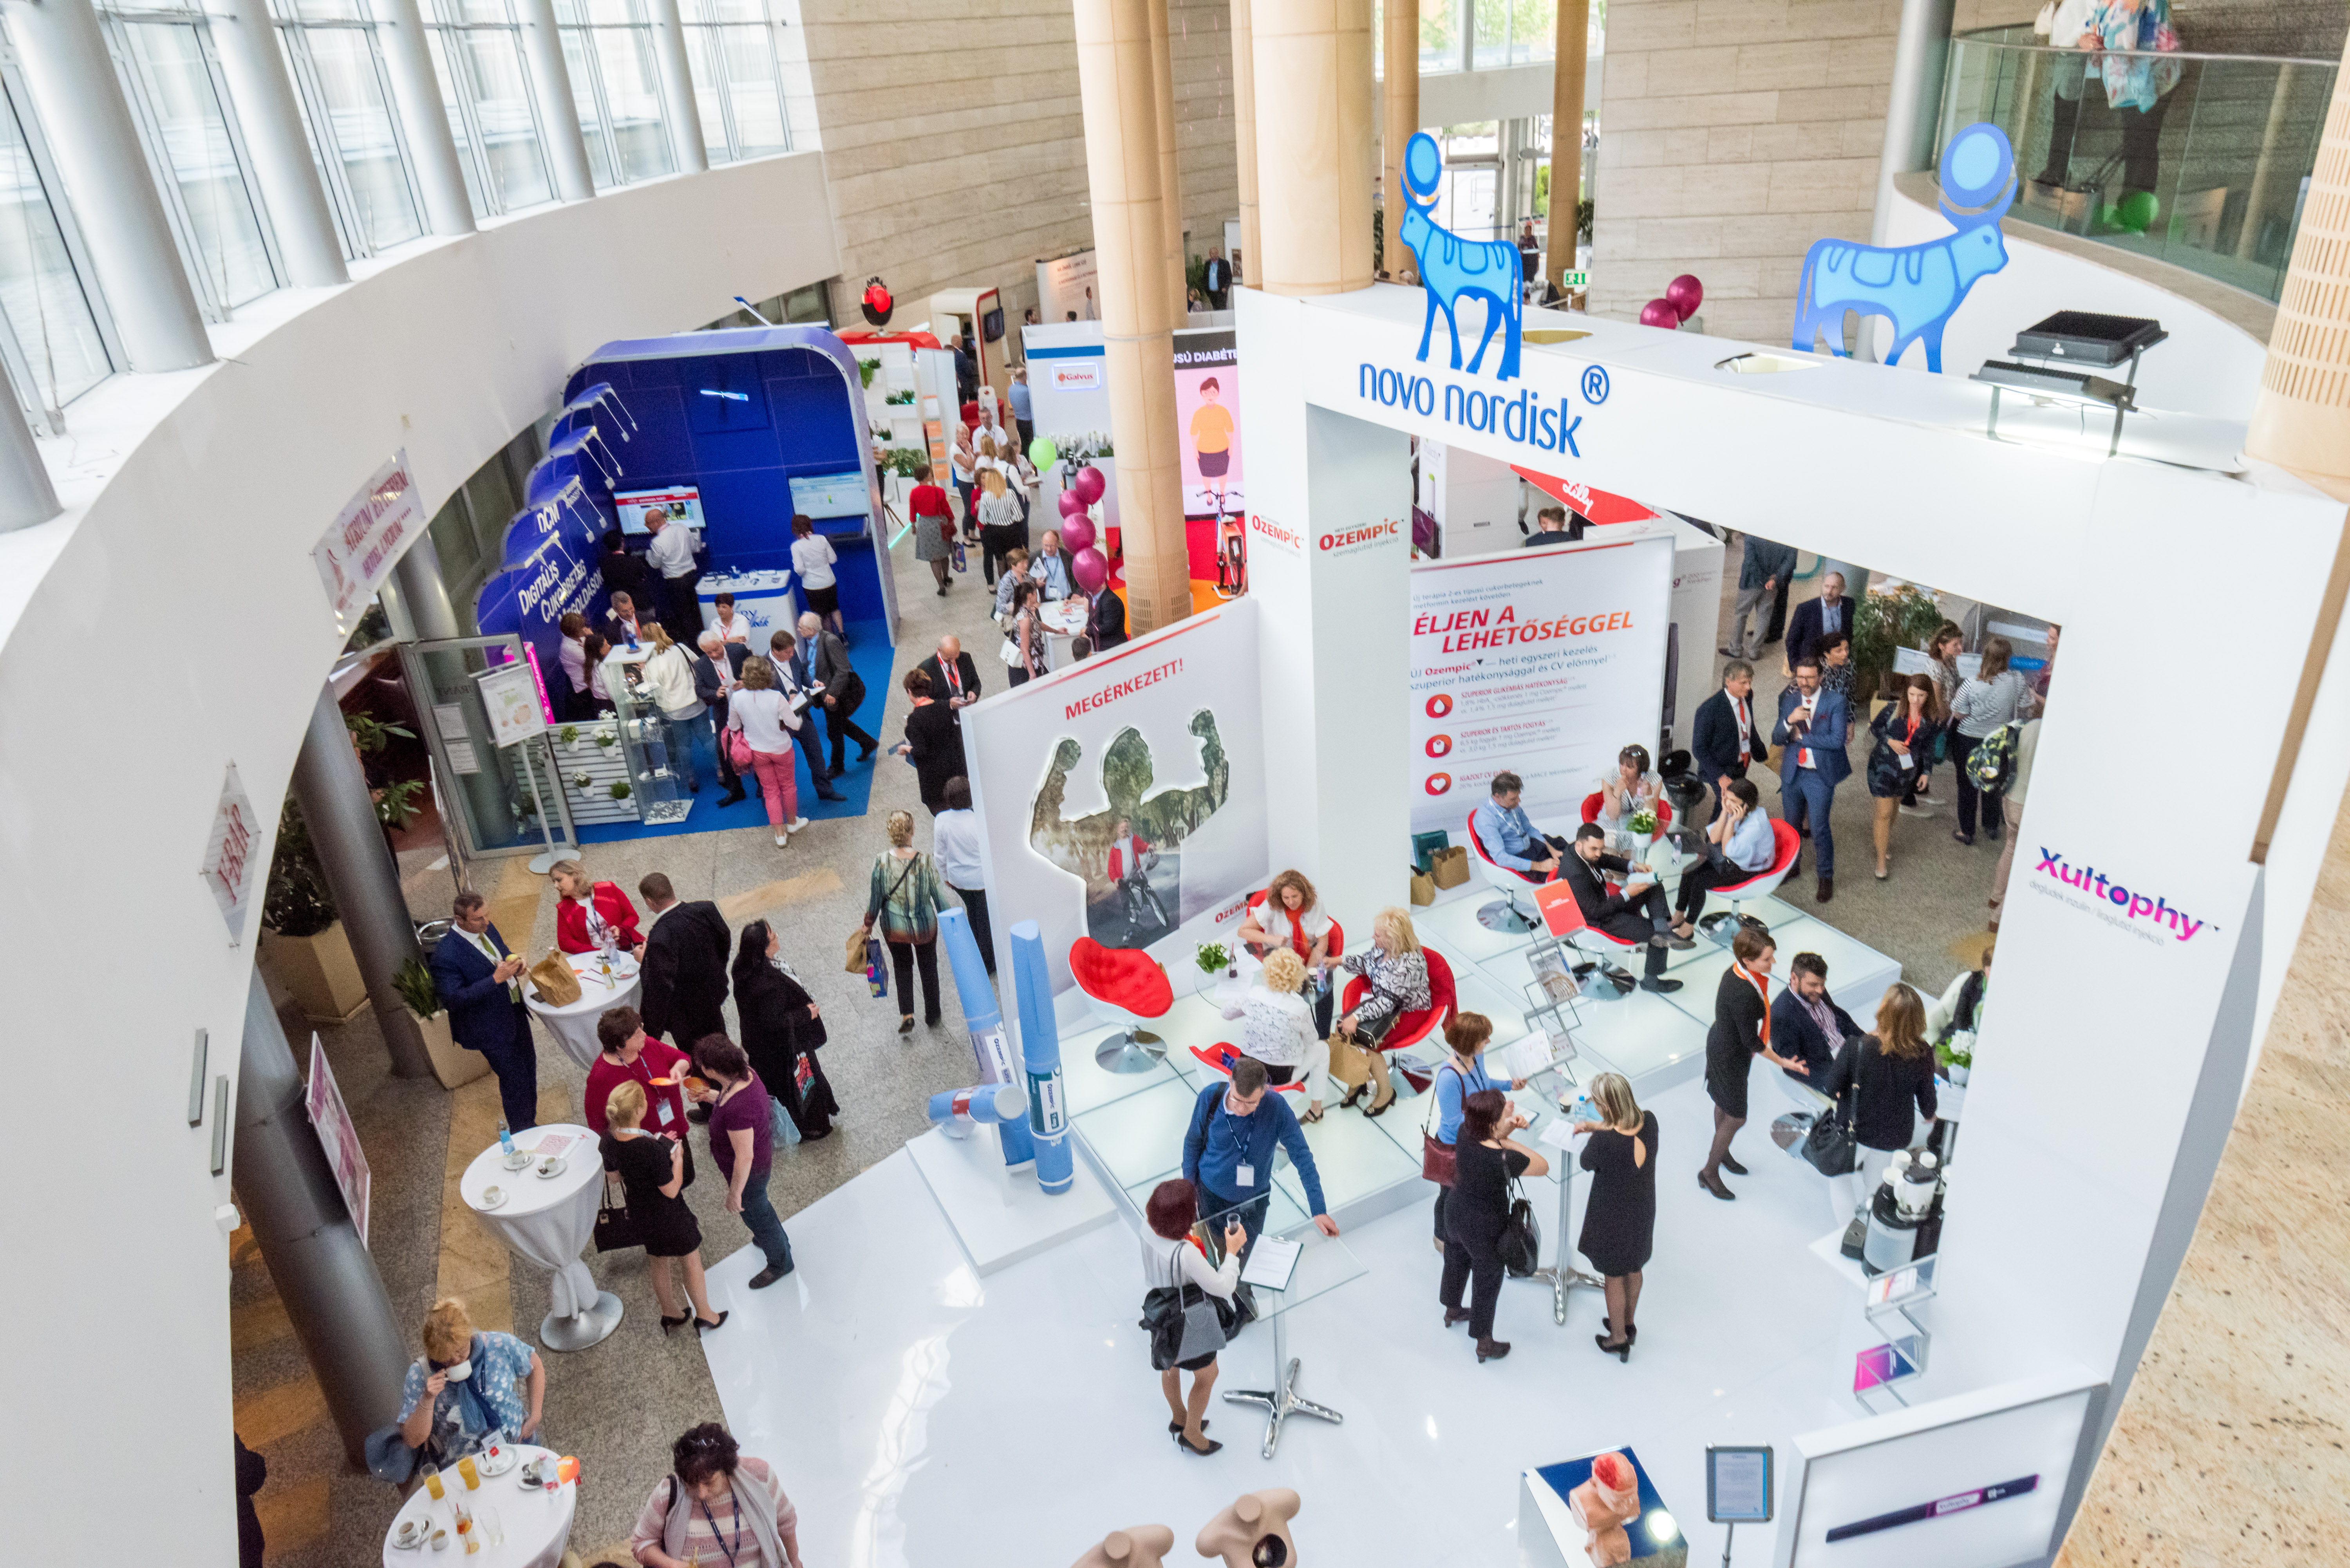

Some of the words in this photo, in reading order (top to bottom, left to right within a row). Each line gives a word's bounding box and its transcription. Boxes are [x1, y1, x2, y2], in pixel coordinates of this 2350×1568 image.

[1360, 363, 1434, 416] novo
[1445, 388, 1582, 457] nordisk
[1562, 480, 1594, 517] Lilly
[518, 560, 560, 616] DIGITÁLIS
[1414, 608, 1490, 636] ÉLJEN
[1496, 605, 1515, 625] A
[1442, 611, 1634, 654] LEHETŐSÉGGEL
[1410, 678, 1455, 692] szuperior
[1459, 665, 1535, 684] hatékonysággal
[1538, 664, 1548, 672] és
[1551, 658, 1565, 670] CV
[1499, 657, 1518, 667] heti
[1520, 651, 1560, 665] egyszeri
[1562, 646, 1598, 658] kezelés
[1065, 658, 1184, 720] MEGÉRKEZETT!
[2035, 845, 2204, 941] Xultophy
